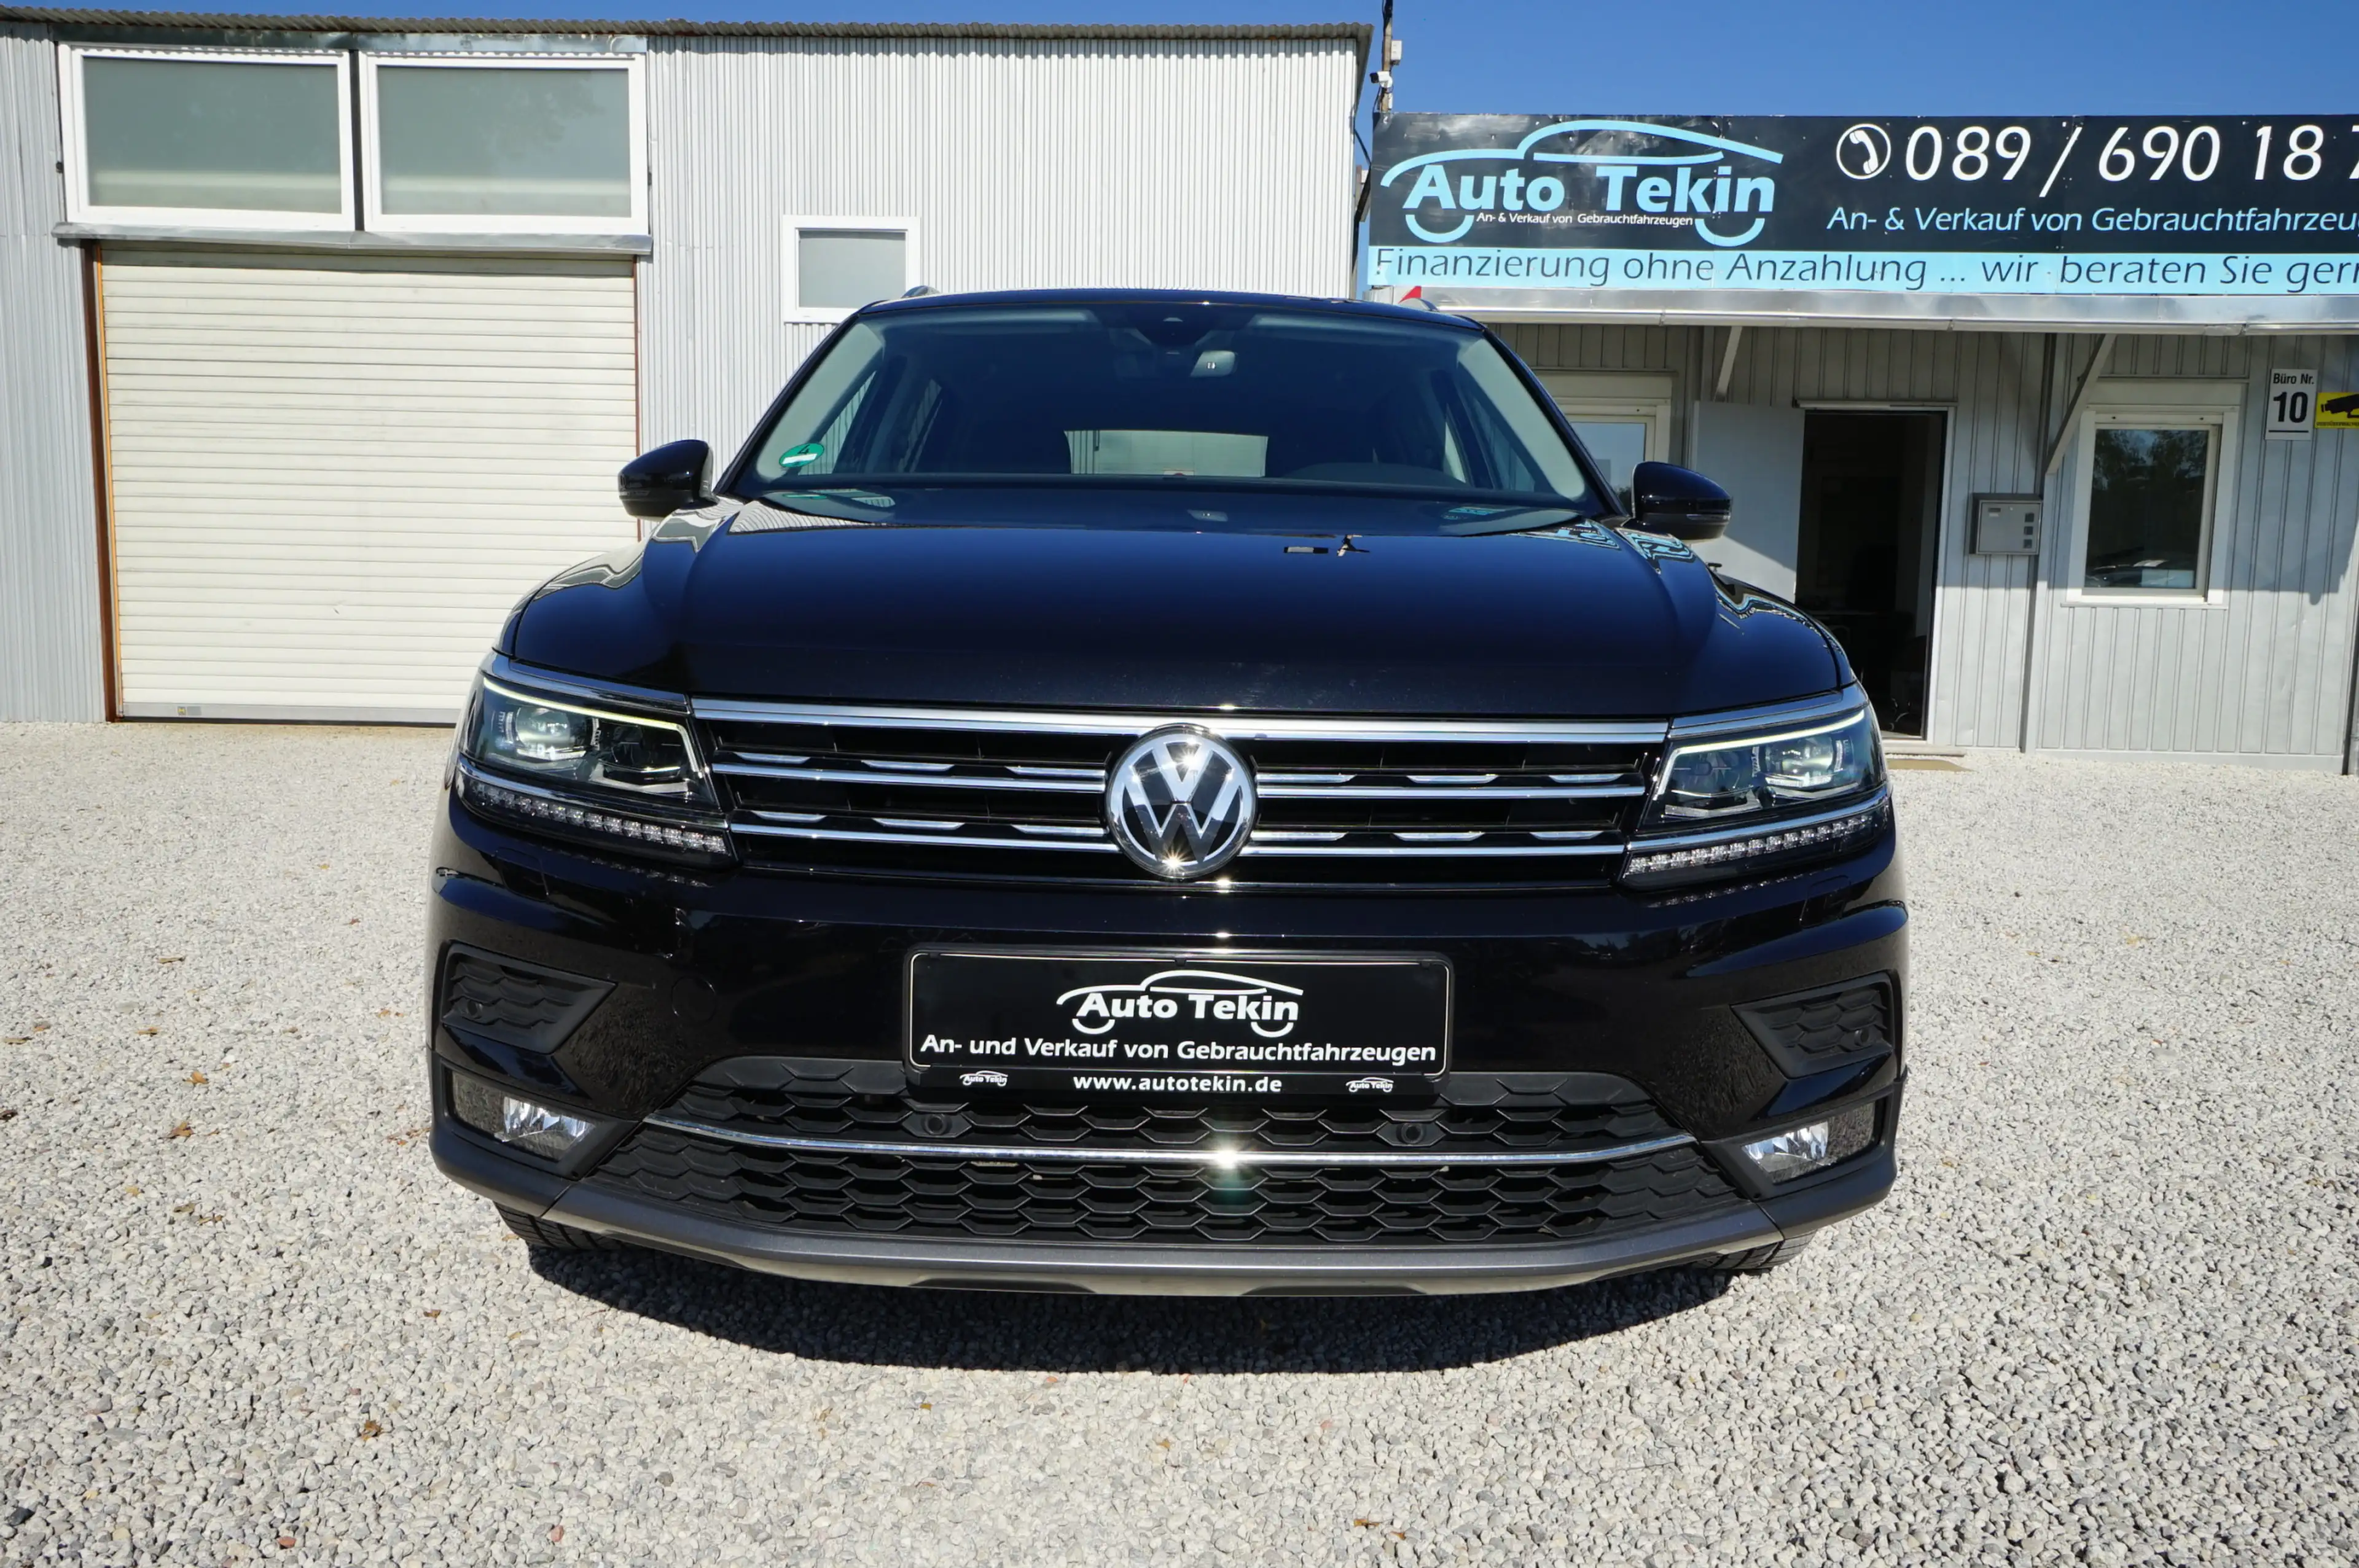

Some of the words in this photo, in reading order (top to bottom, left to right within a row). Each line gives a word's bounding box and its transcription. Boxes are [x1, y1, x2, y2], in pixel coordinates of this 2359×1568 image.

[2099, 125, 2220, 182] 690
[2255, 125, 2325, 181] 18
[1402, 164, 1565, 212] Auto
[1596, 166, 1775, 213] Tekin
[1476, 212, 1496, 222] An-
[1498, 212, 1507, 223] &
[1509, 212, 1552, 224] Verkauf
[1552, 214, 1573, 224] von
[1577, 213, 1693, 227] Gebrauchtfahrzeugen
[1826, 206, 1877, 230] An-
[1884, 207, 1905, 230] &
[1915, 207, 2026, 231] Verkauf
[2031, 213, 2083, 232] von
[2092, 207, 2359, 238] Gebrauchtfahrzeu
[1376, 248, 1609, 286] Finanzierung
[1624, 252, 1714, 280] ohne
[1726, 253, 1927, 291] Anzahlung
[1982, 255, 2039, 283] wir
[2060, 255, 2206, 284] beraten
[2220, 255, 2272, 284] Sie
[2273, 373, 2297, 384] Büro
[2300, 373, 2314, 385] Nr.
[2273, 391, 2308, 423] 10
[797, 444, 810, 454] 4
[1076, 993, 1178, 1018] Auto
[1188, 994, 1299, 1021] Tekin
[920, 1034, 963, 1053] An-
[969, 1037, 1017, 1055] und
[1024, 1037, 1118, 1058] Verkauf
[1124, 1044, 1168, 1058] von
[1177, 1040, 1436, 1066] Gebrauchtfahrzeugen
[1073, 1075, 1283, 1093] www.autotekin.de
